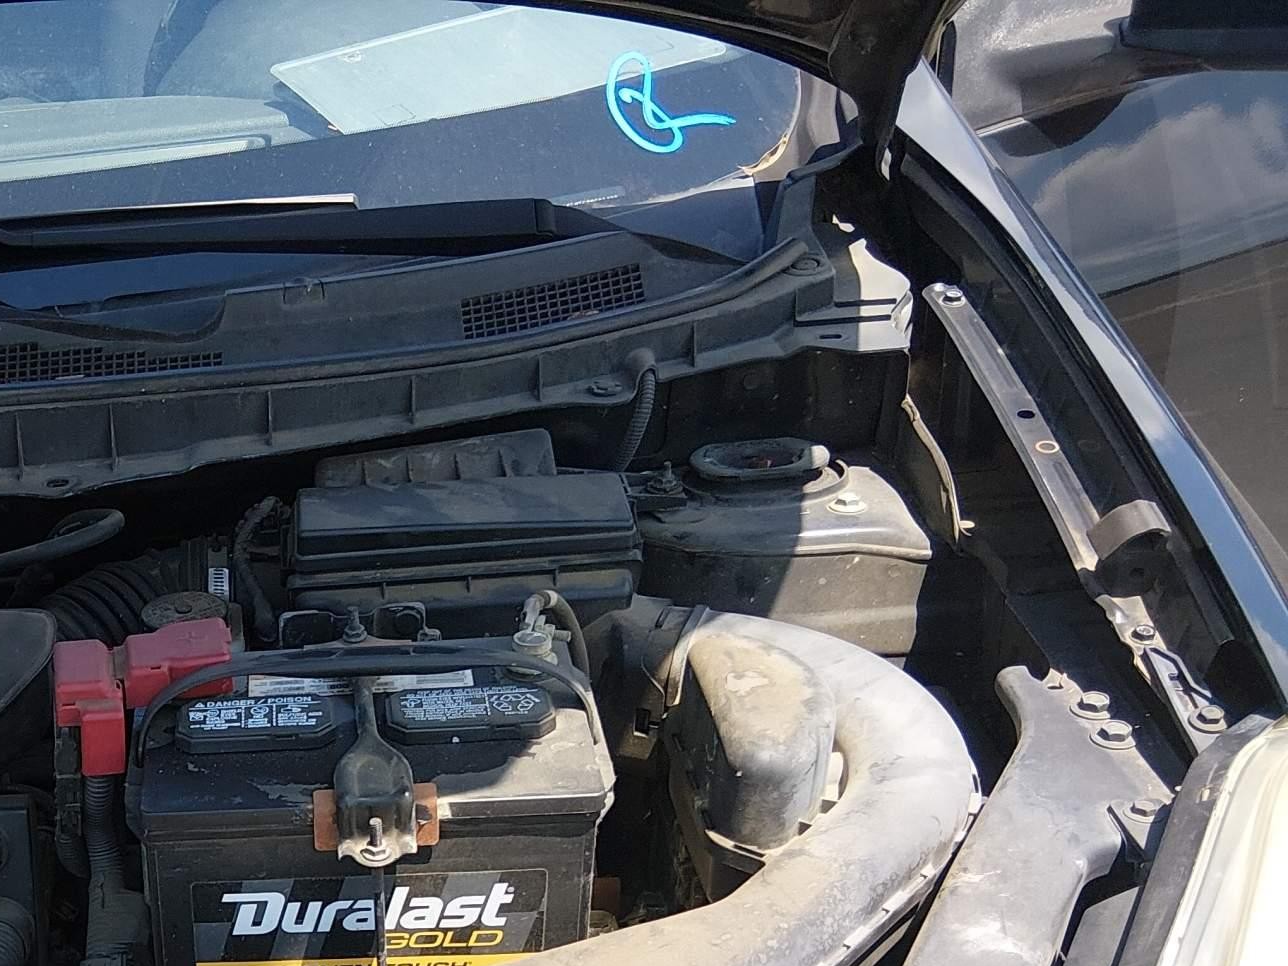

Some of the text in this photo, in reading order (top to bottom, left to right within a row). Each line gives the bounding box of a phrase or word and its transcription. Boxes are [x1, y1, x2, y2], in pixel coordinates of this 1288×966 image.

[207, 699, 255, 707] DANGER
[268, 696, 312, 704] POISON
[222, 882, 514, 936] Duralast
[385, 929, 504, 949] GOLD
